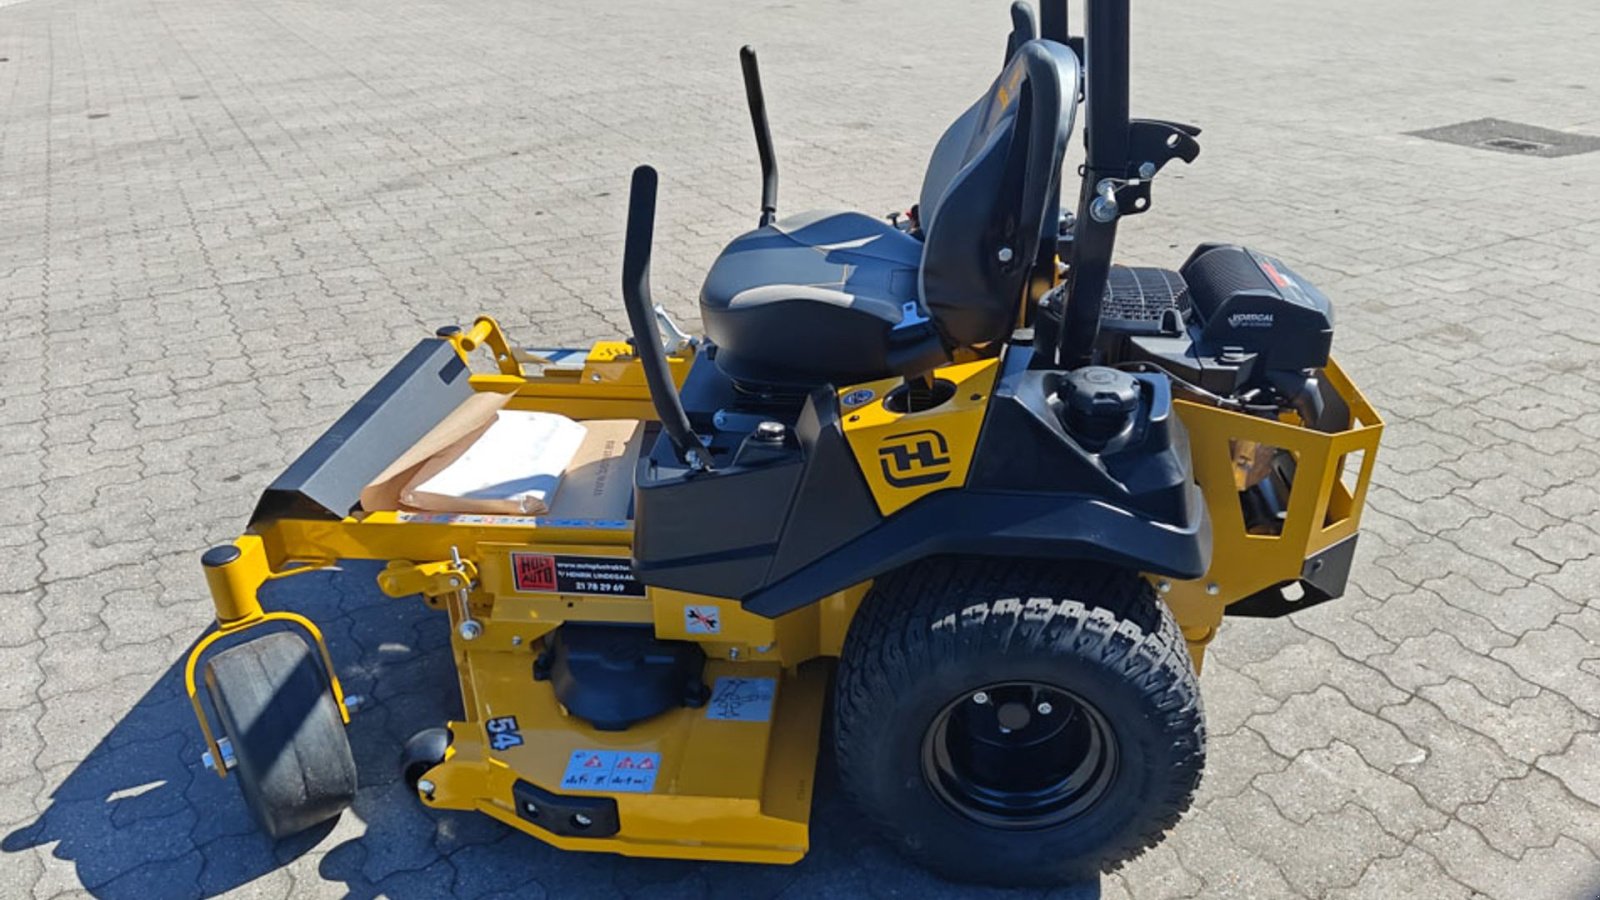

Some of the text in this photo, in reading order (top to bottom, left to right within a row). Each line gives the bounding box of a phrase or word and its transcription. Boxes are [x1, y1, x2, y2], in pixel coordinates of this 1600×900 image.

[522, 567, 553, 584] AUTO
[566, 571, 592, 579] HENRIK
[576, 582, 625, 592] 21 78 29 69
[487, 716, 523, 750] 54
